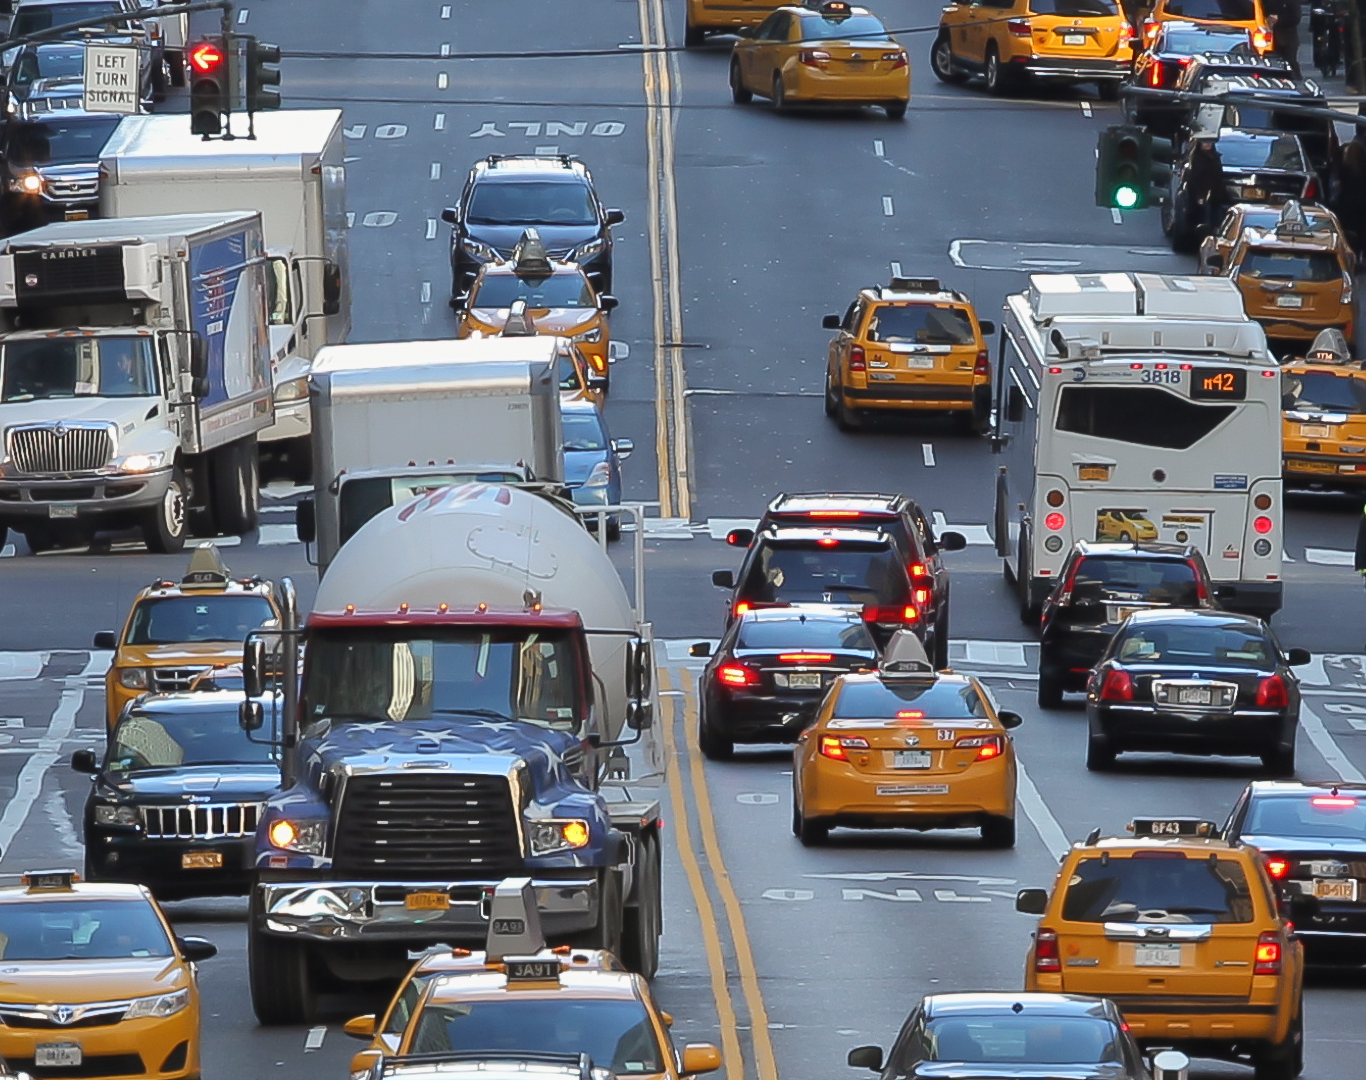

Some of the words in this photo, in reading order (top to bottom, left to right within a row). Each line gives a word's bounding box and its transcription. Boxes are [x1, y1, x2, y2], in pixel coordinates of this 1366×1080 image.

[96, 55, 127, 69] LEFT
[95, 72, 128, 86] TURN
[88, 89, 133, 104] SIGNAL
[41, 248, 98, 260] CARRIER
[1140, 369, 1182, 384] 3818
[937, 729, 954, 741] 37
[1150, 821, 1180, 834] 6F43
[511, 962, 552, 978] 3A91
